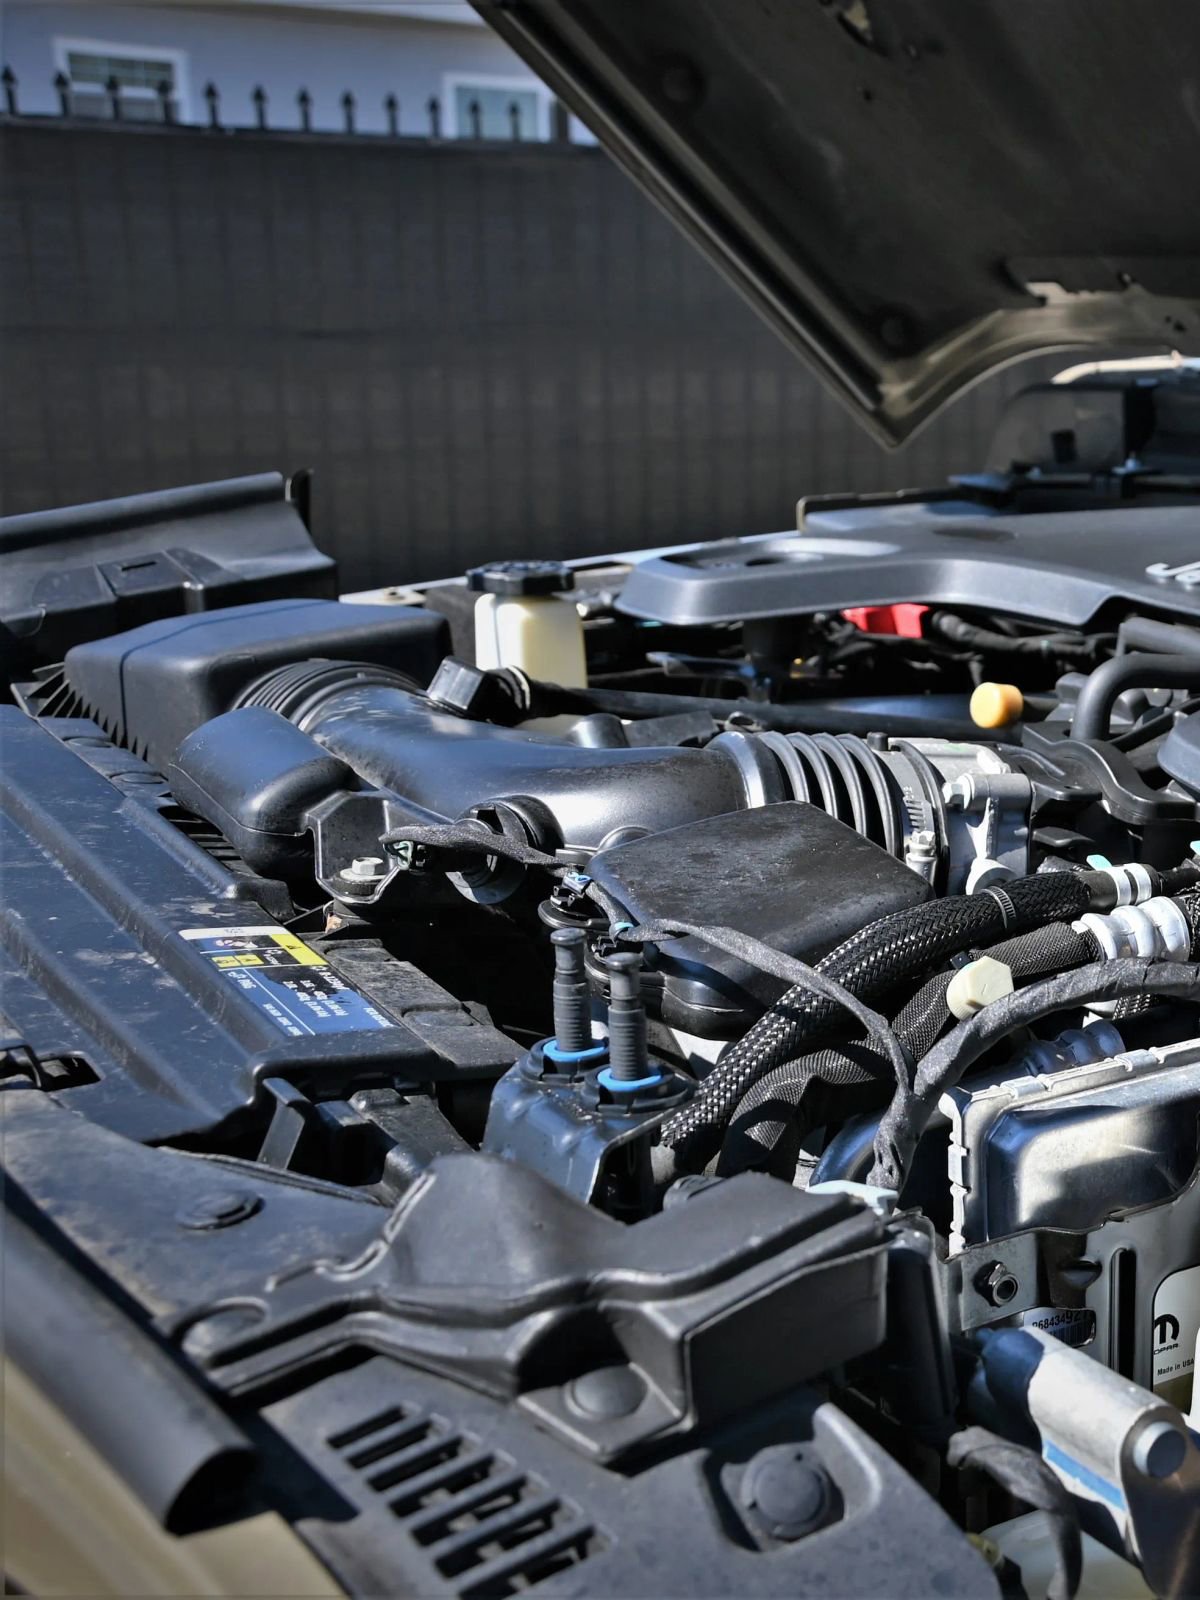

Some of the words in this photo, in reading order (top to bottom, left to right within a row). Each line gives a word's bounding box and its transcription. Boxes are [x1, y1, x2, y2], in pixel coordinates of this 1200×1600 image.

[1153, 1343, 1179, 1356] OPAR
[1157, 1366, 1173, 1376] Made
[1183, 1358, 1194, 1367] USA
